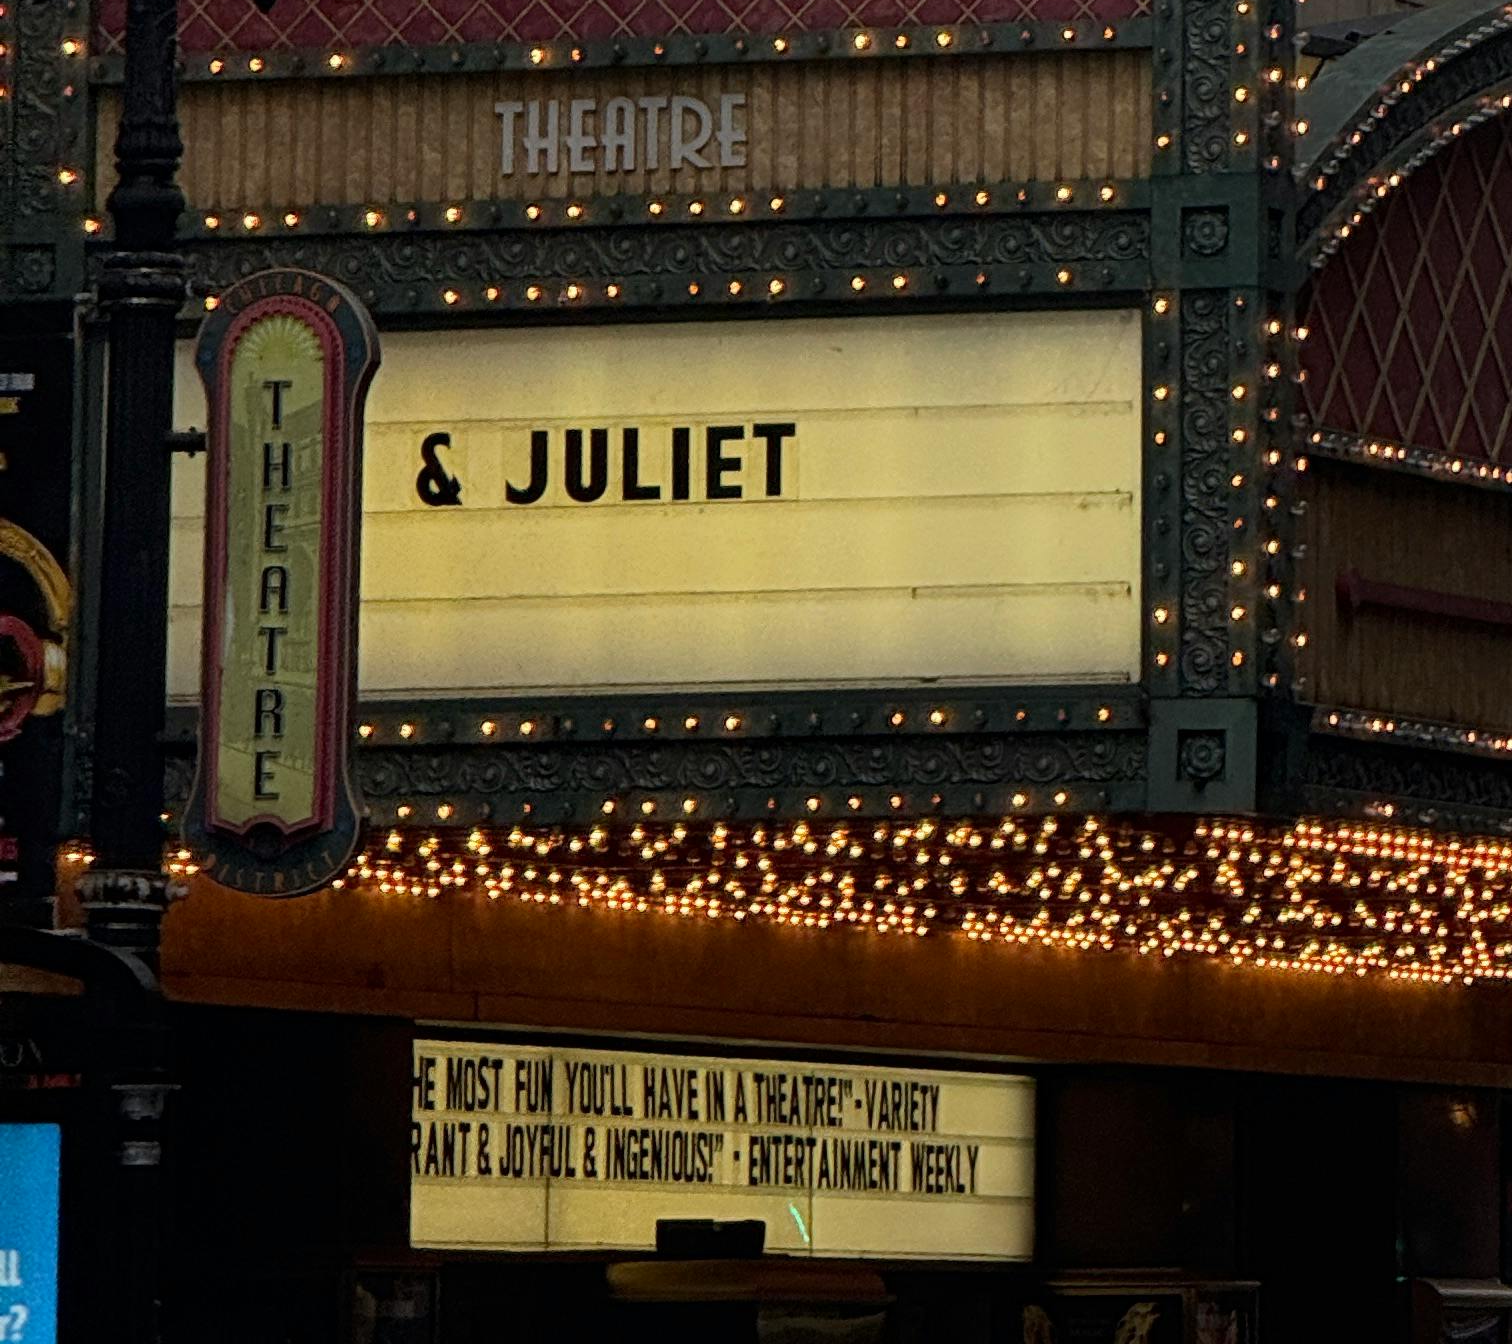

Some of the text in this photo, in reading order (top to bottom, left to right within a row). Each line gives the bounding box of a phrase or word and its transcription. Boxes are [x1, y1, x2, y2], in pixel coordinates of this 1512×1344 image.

[494, 92, 749, 177] THEATRE
[416, 422, 796, 506] & JULIET
[253, 379, 293, 801] THEATRE
[446, 1057, 502, 1112] MOST
[515, 1060, 552, 1113] FUN
[644, 1066, 699, 1120] HAVE
[706, 1070, 726, 1122] IN
[734, 1072, 748, 1124] A
[478, 1123, 492, 1176] &
[500, 1123, 576, 1179] JOYFUL
[583, 1127, 597, 1178] &
[749, 1135, 902, 1190] ENTERTAINMENT
[910, 1142, 980, 1194] WEEKLY
